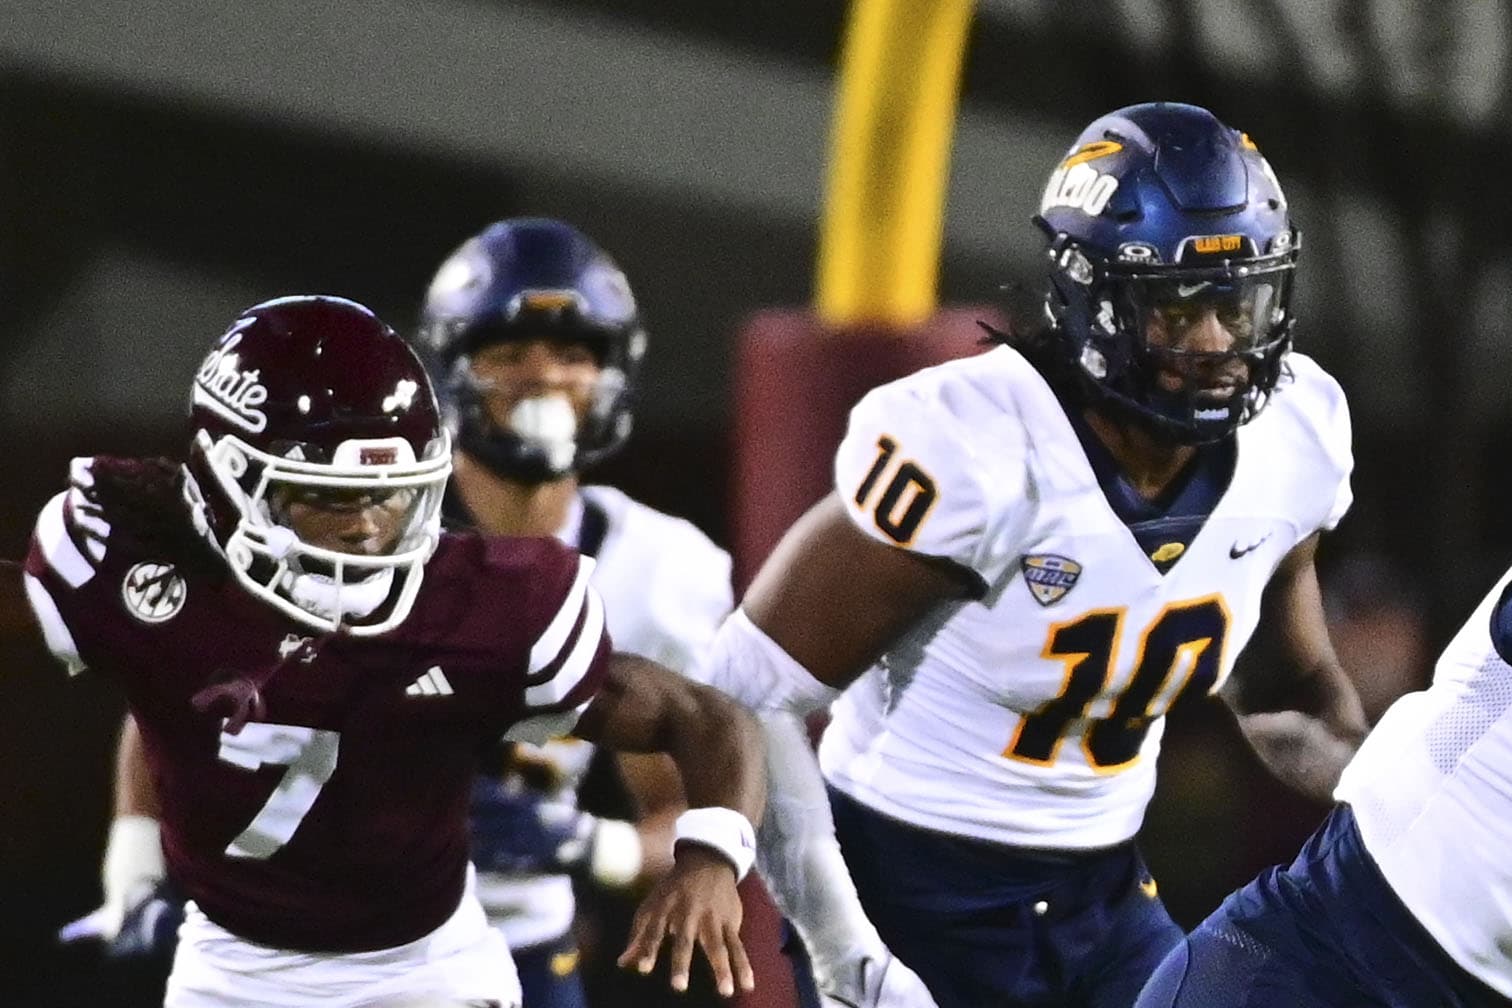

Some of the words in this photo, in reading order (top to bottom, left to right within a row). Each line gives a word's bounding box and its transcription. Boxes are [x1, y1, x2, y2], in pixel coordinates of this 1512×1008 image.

[855, 432, 937, 548] 10
[1004, 592, 1232, 776] 10
[217, 719, 341, 860] 7
